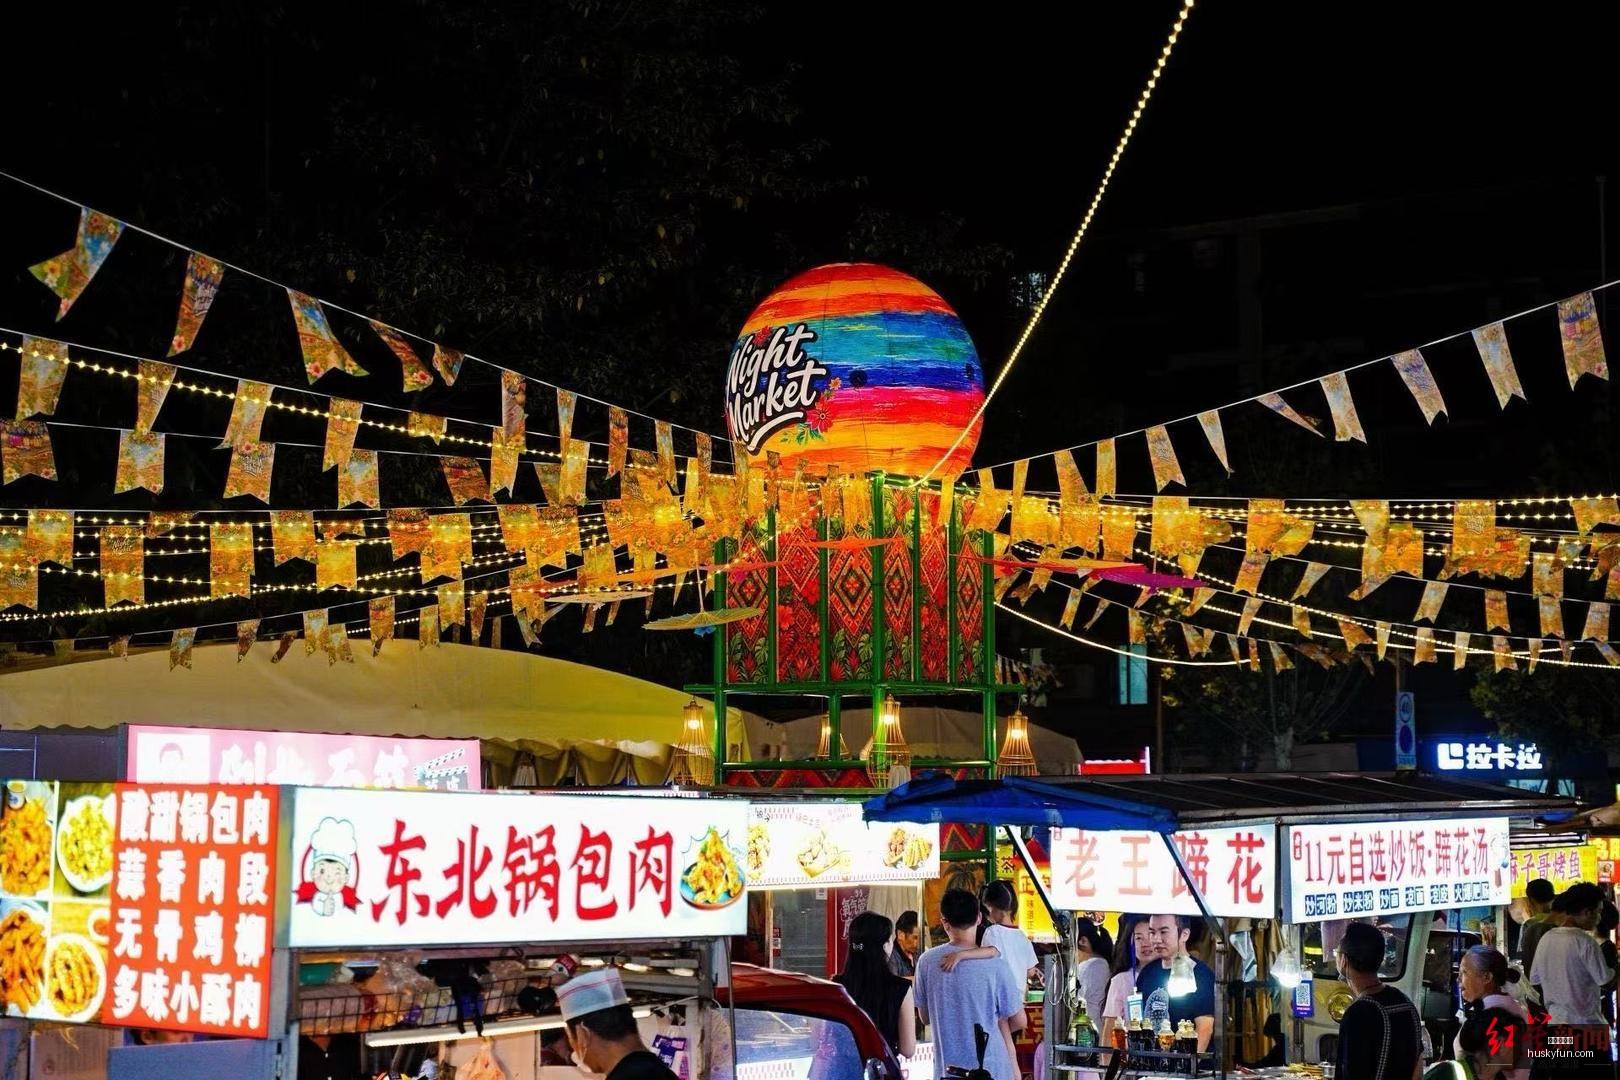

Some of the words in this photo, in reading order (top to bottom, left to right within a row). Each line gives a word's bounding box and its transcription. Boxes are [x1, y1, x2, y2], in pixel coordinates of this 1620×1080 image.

[727, 325, 813, 400] Night
[729, 360, 826, 441] Market
[1467, 743, 1543, 770] 拉卡拉
[119, 789, 271, 845] 酸甜锅包肉
[116, 847, 270, 906] 蒜香肉段
[370, 819, 675, 925] 东北锅包肉
[1065, 829, 1265, 904] 老王蹄花
[1305, 893, 1337, 916] 炒河粉
[1343, 890, 1374, 914] 炒米粉
[1380, 888, 1399, 910] 炒面
[114, 907, 267, 968] 无骨鸡柳
[112, 965, 263, 1030] 多味小酥肉
